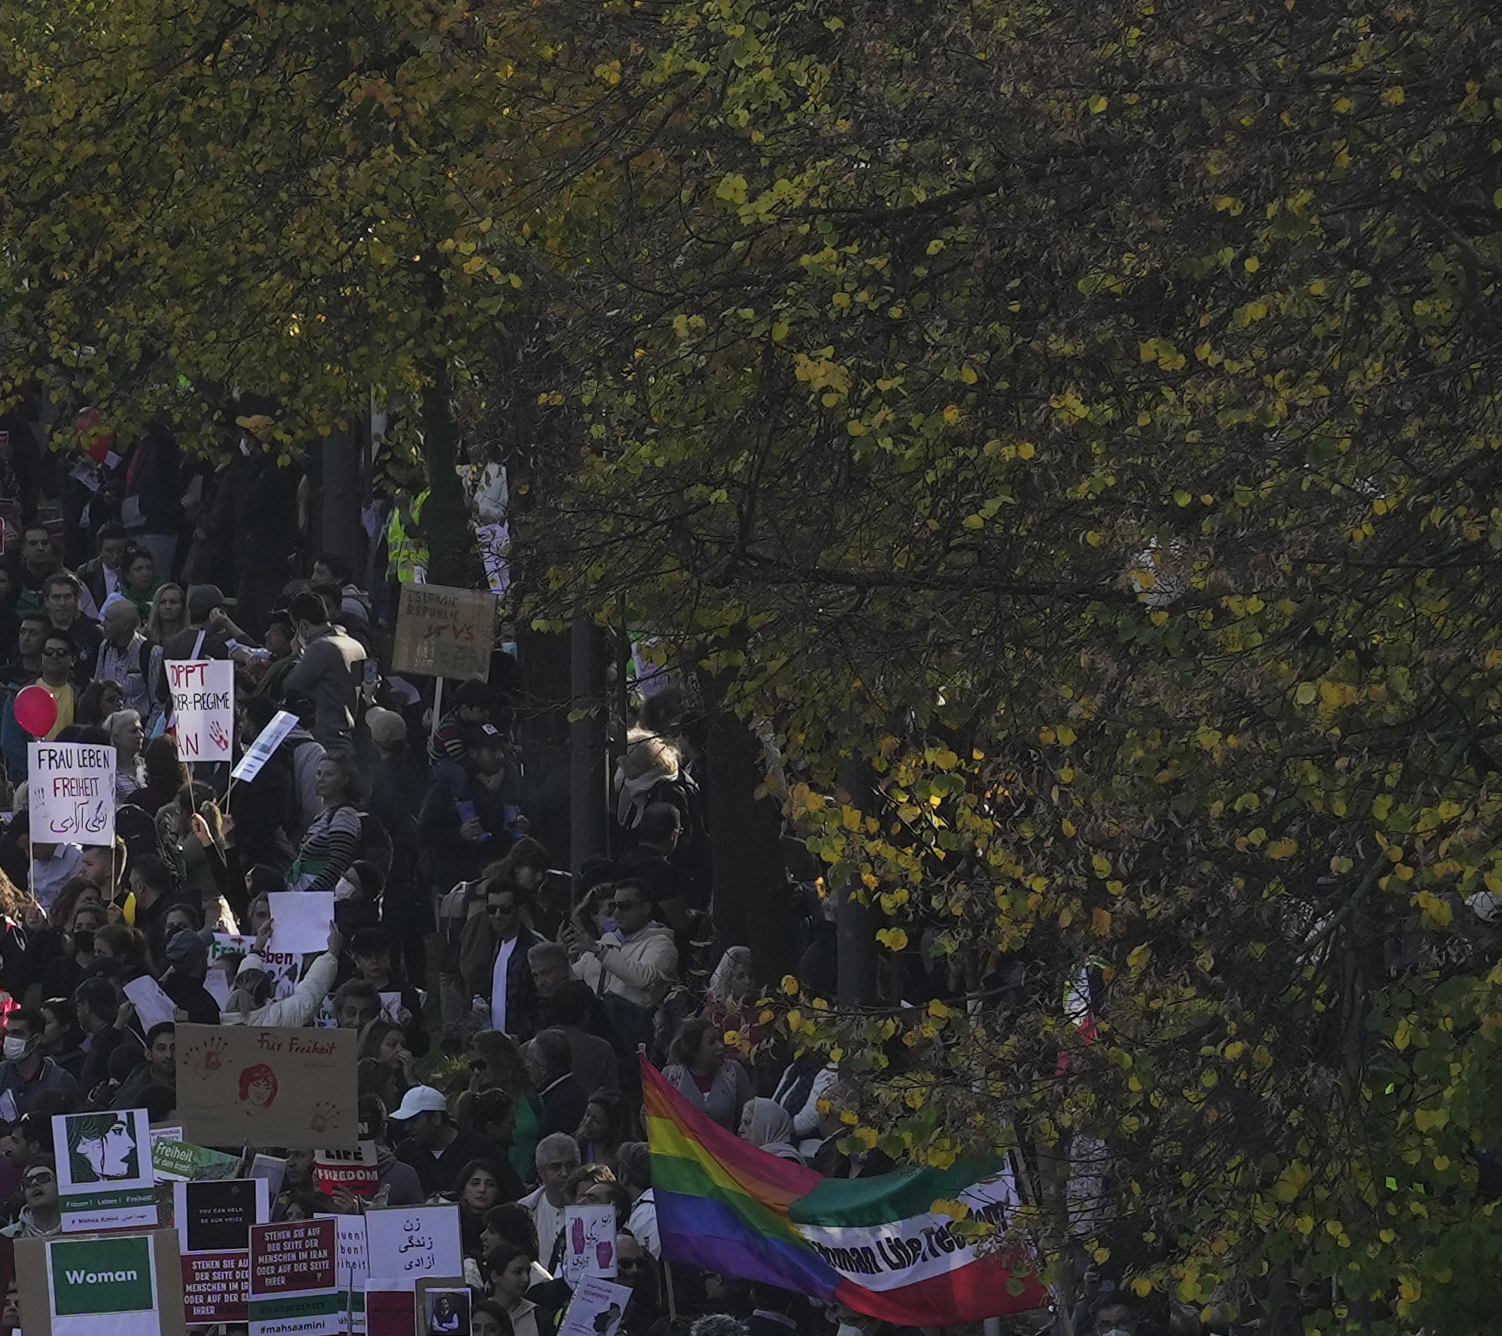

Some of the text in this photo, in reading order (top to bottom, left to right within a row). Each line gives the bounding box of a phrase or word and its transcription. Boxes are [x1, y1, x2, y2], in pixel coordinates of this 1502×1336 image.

[37, 748, 111, 770] FRAU LEBEN
[52, 776, 100, 799] FREIHEIT
[258, 1252, 296, 1264] MENSCHEN
[310, 1248, 328, 1260] IRAN
[65, 1266, 138, 1286] Woman
[256, 1260, 330, 1276] ODER AUF DER SEITE
